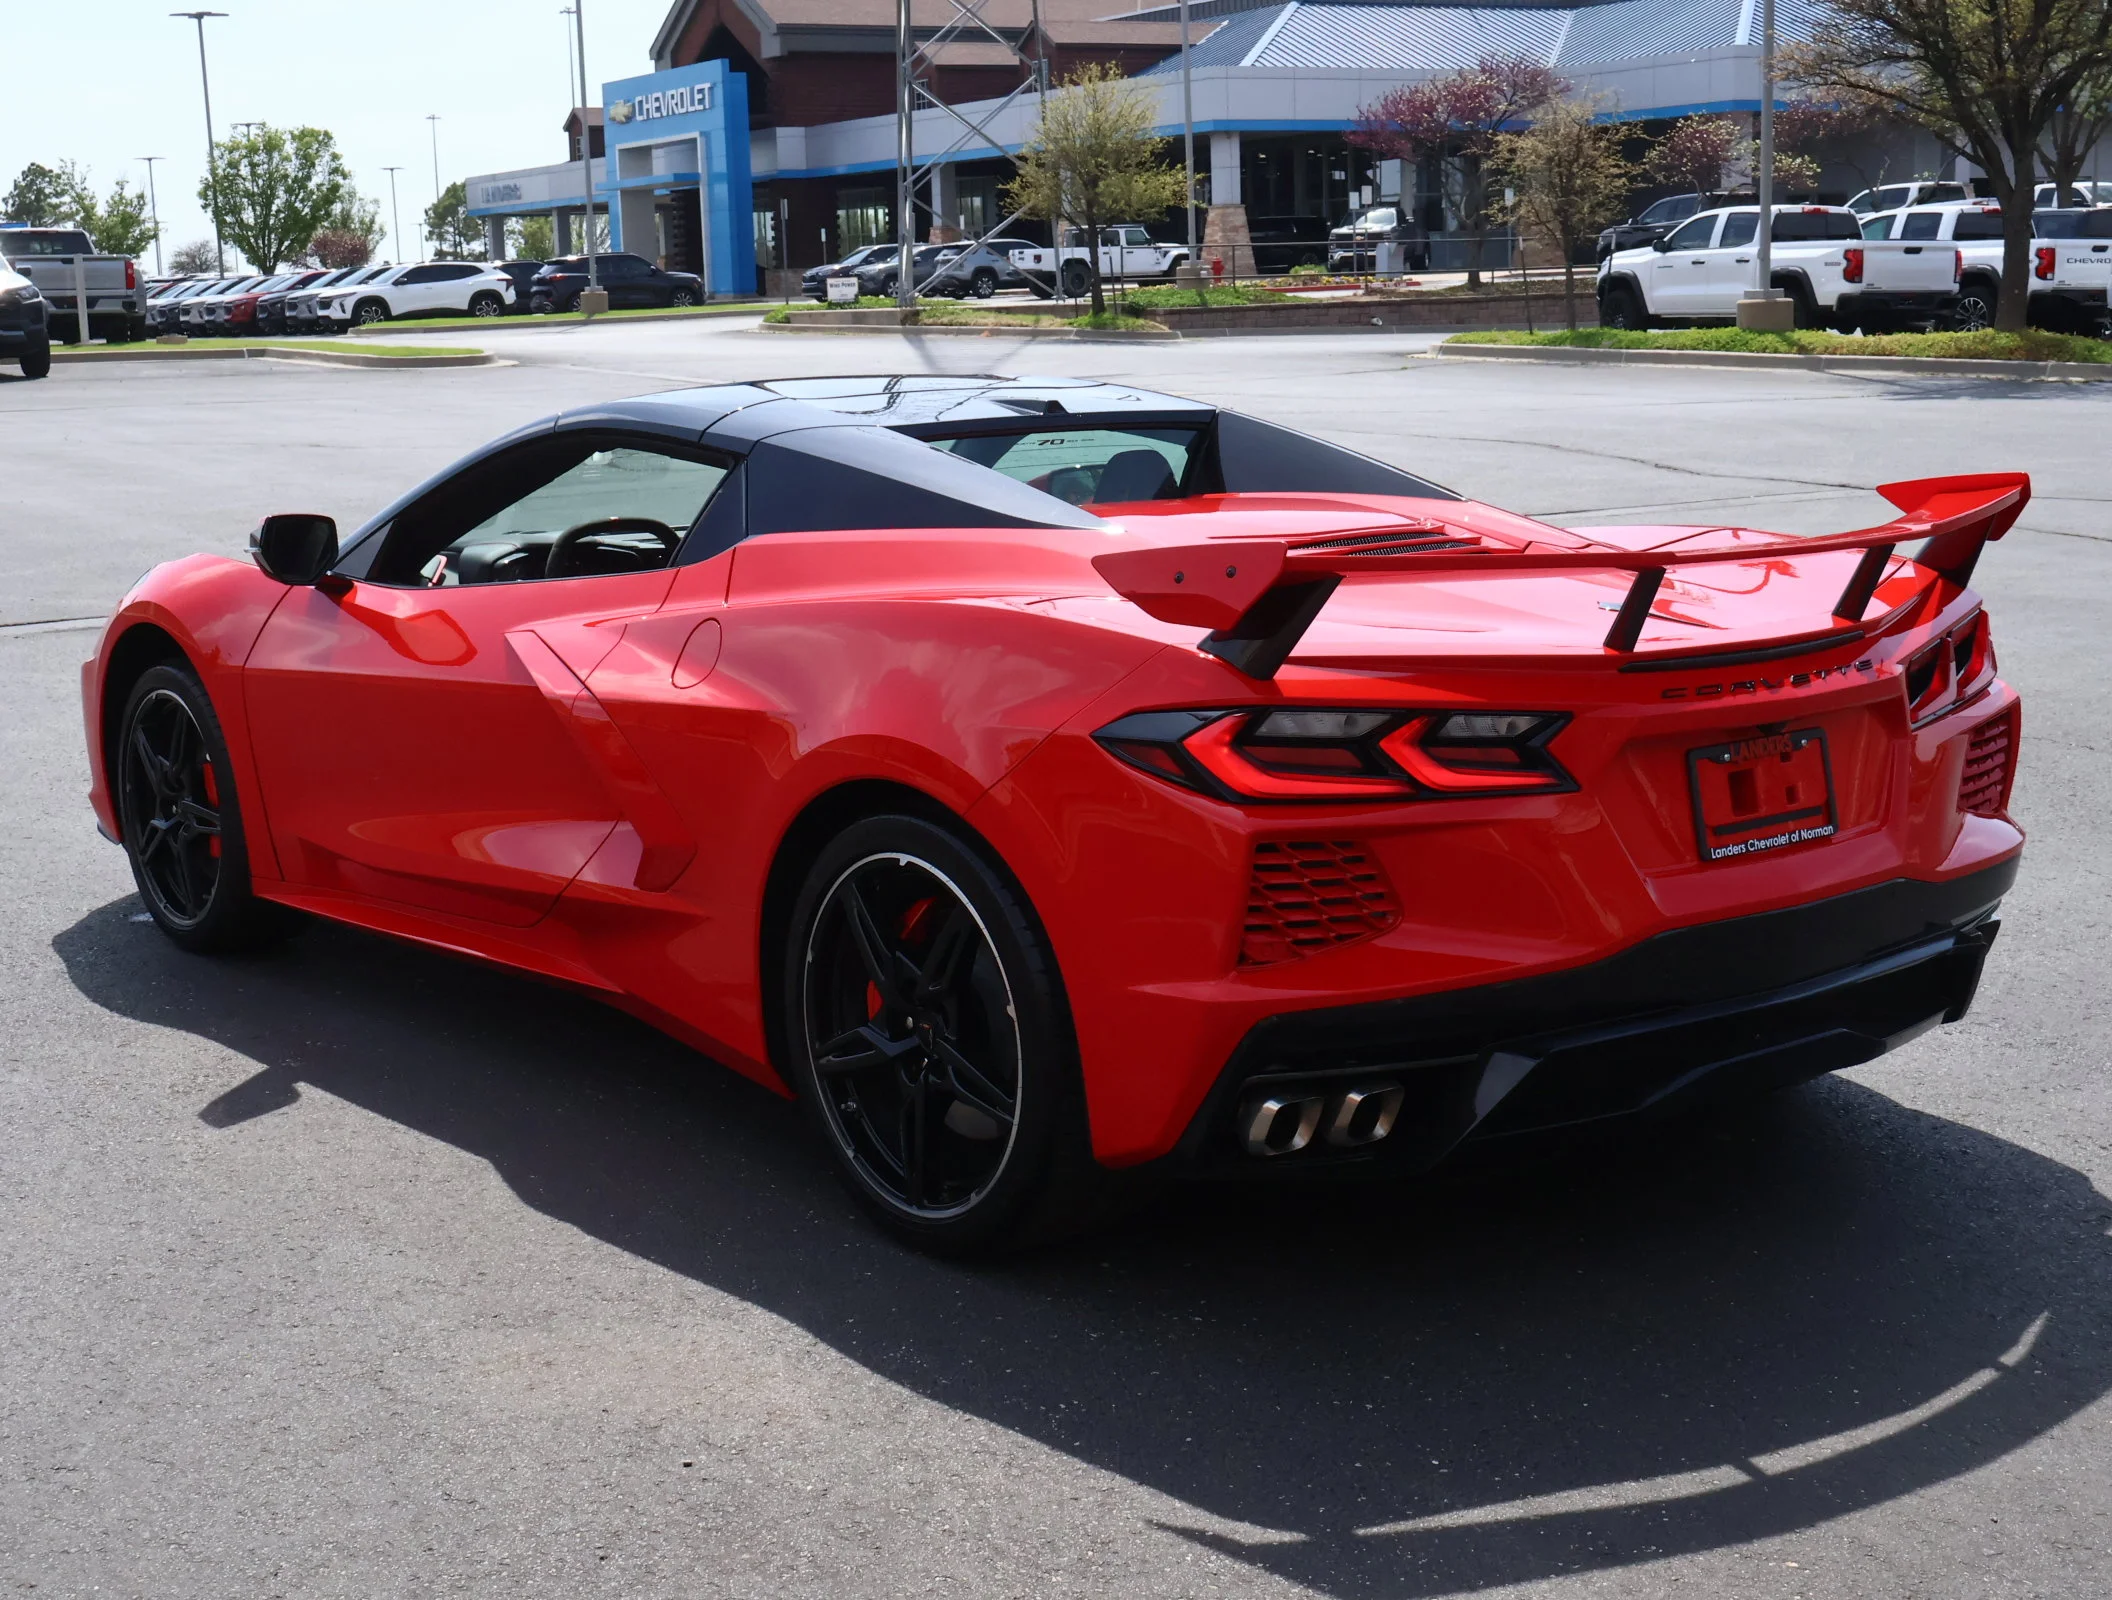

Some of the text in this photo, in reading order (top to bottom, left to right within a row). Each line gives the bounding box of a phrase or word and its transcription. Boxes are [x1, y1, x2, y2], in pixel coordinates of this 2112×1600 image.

[635, 82, 711, 121] CHEVROLET
[1037, 438, 1065, 446] 70
[1661, 659, 1873, 698] CORVETTE
[1730, 734, 1793, 761] LANDERS
[1710, 825, 1834, 859] Landers Chevrolet of Norman
